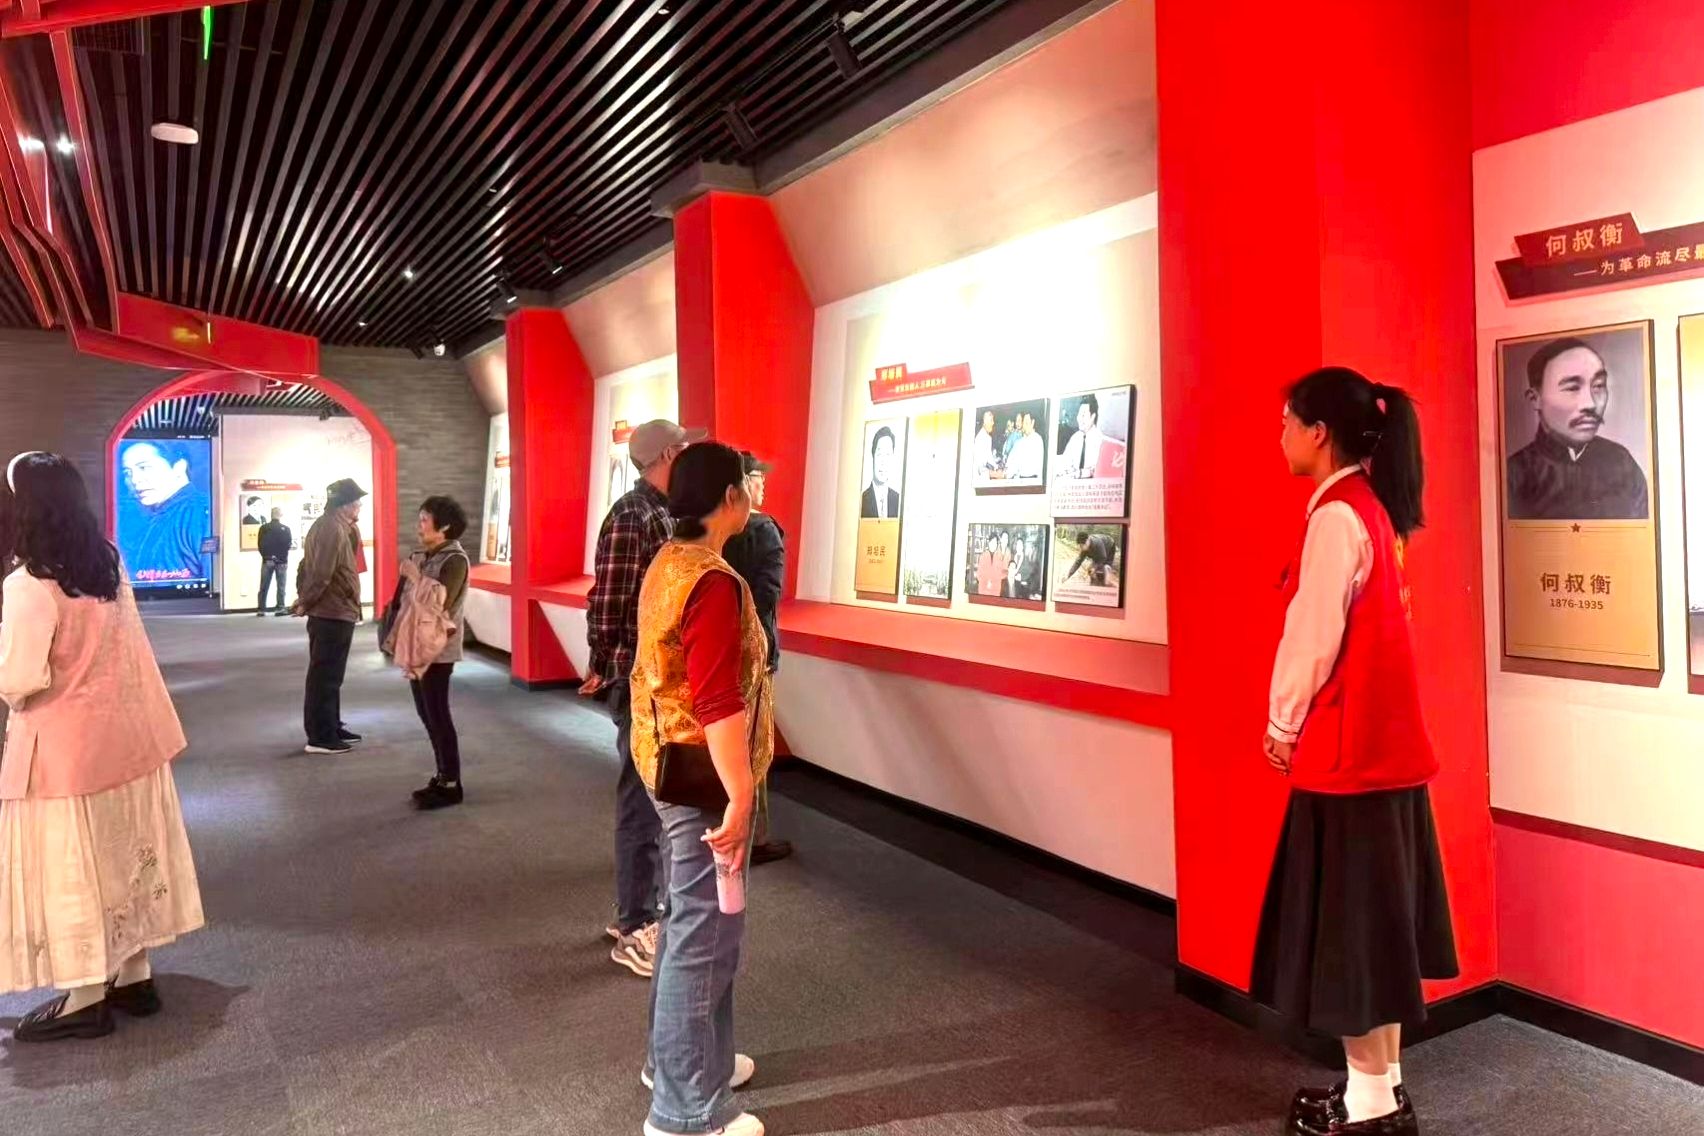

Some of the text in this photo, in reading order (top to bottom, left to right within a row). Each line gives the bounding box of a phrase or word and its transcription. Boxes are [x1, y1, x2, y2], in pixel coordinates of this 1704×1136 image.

[1546, 222, 1623, 257] 何叔衡
[1540, 572, 1611, 594] 何叔衡
[1550, 598, 1604, 610] 1876-1935
